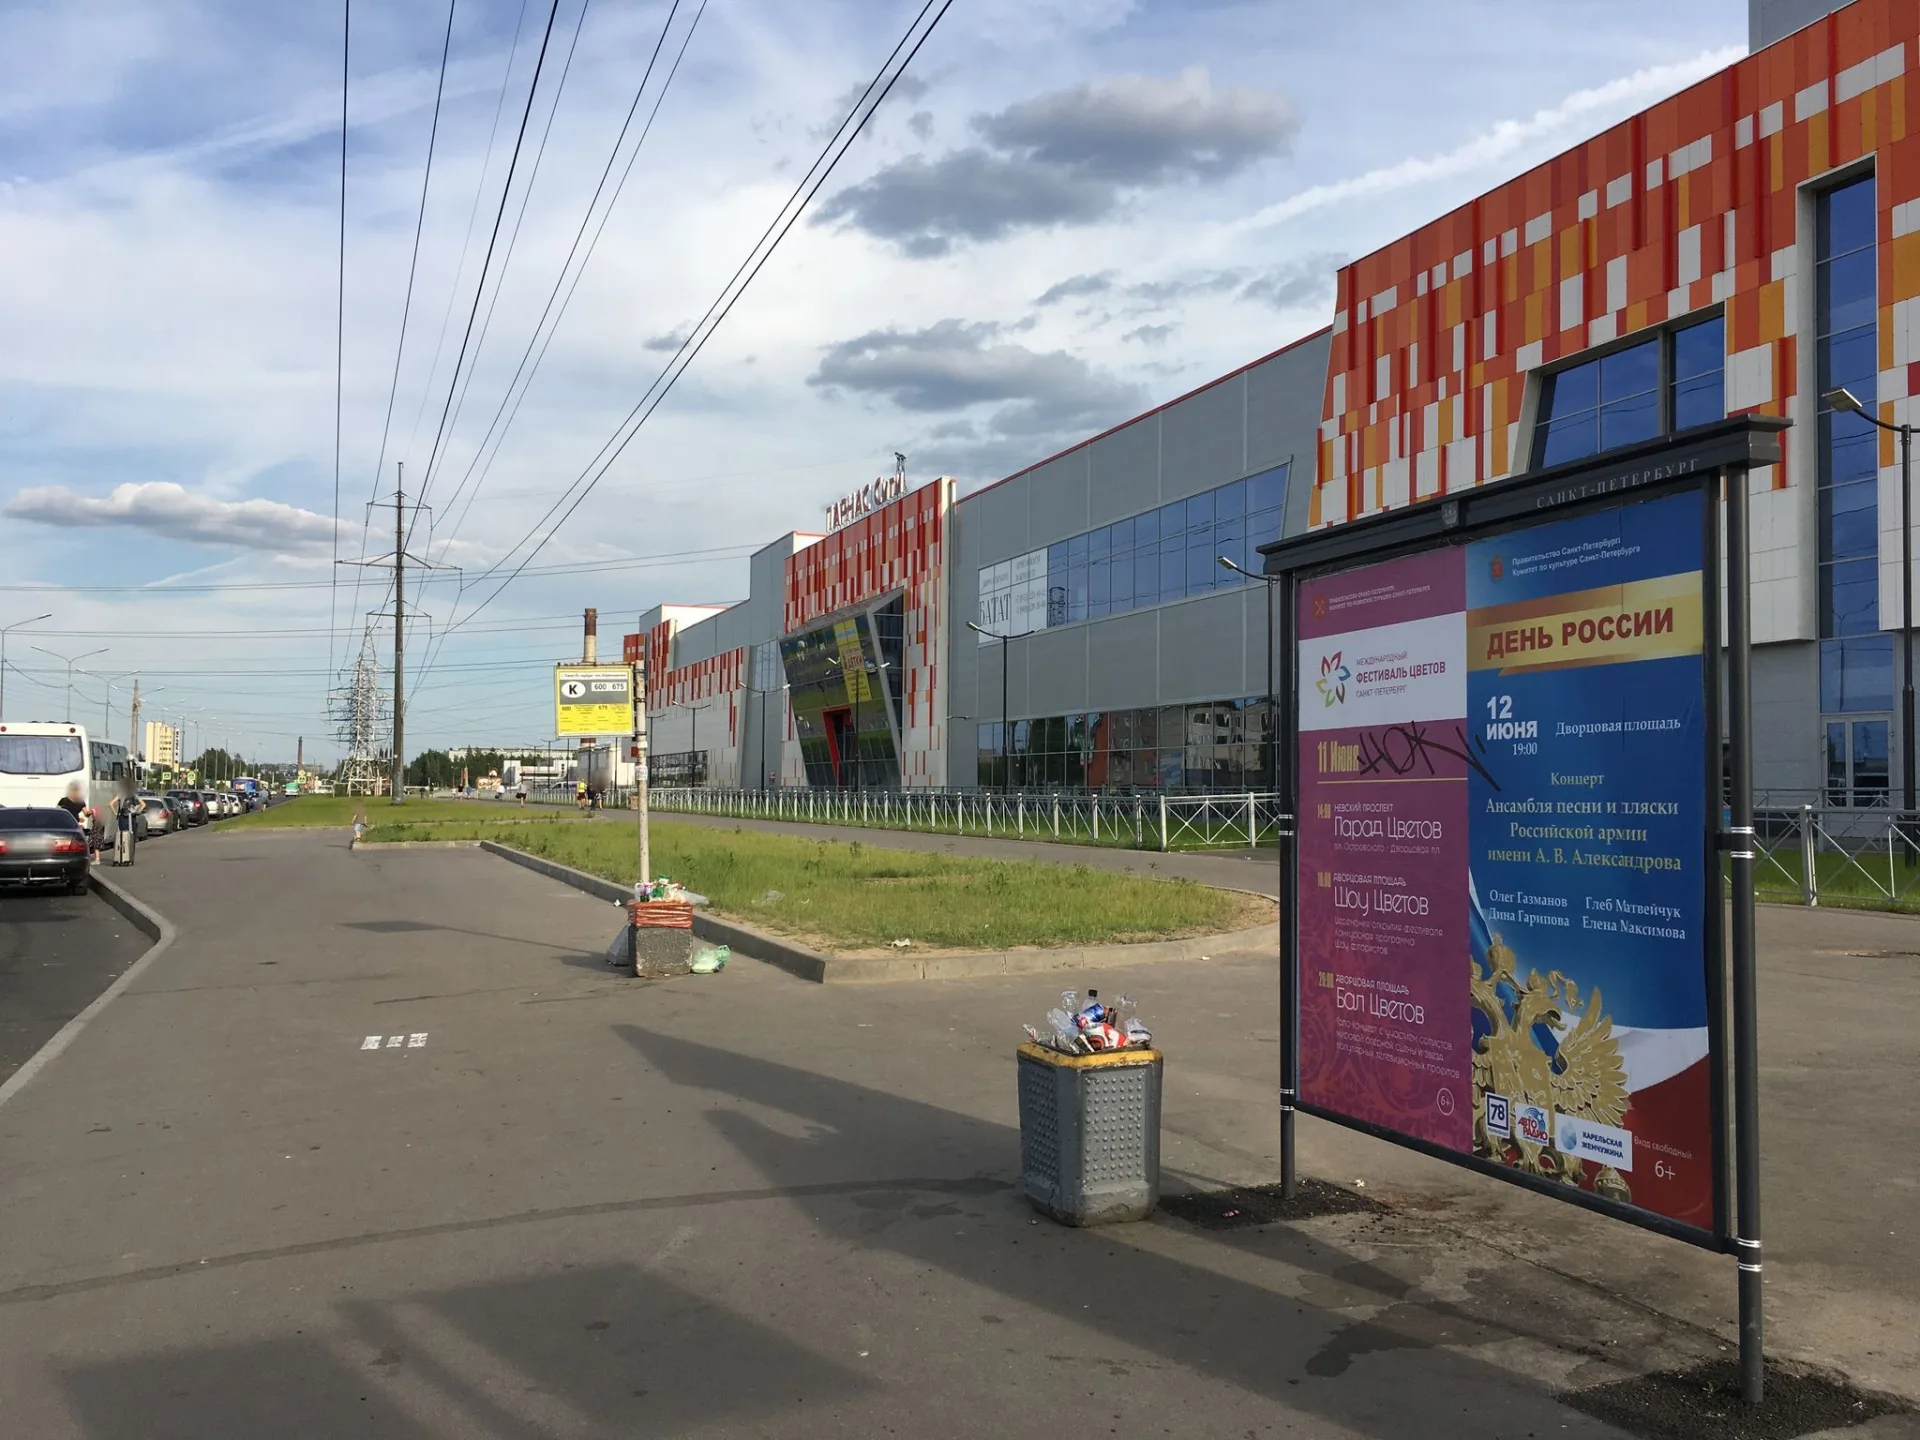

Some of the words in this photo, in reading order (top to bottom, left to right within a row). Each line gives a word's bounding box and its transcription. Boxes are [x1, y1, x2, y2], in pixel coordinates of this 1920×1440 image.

[1536, 458, 1700, 508] САНКТ-ПЕТЕРБУРГ
[826, 484, 872, 532] ПАРНАС
[1512, 549, 1560, 566] Правительство
[1512, 564, 1538, 577] Комитет
[1539, 564, 1548, 572] по
[1548, 558, 1578, 571] культуре
[1579, 544, 1640, 564] Санкт-Петербурга
[980, 594, 1011, 626] БАТАТ
[1487, 626, 1554, 660] ДЕНЬ
[1562, 608, 1674, 646] РОССИИ
[1356, 651, 1408, 667] МЕЖДУНАРОДНЫЙ
[1356, 667, 1408, 684] ФЕСТИВАЛЬ
[1410, 662, 1446, 678] ЦВЕТОВ
[1356, 684, 1408, 698] САНКТ-ПЕТЕРБУРГ
[1486, 695, 1512, 720] 12
[1486, 720, 1538, 740] ИЮНЯ
[1556, 720, 1622, 738] Дворцовая
[1624, 718, 1681, 732] площадь
[1318, 741, 1327, 772] 11
[1330, 741, 1360, 772] Июня
[1512, 742, 1538, 756] 19:00
[1551, 772, 1604, 788] Концерт
[1334, 802, 1362, 812] НЕВСКИЙ
[1362, 802, 1394, 812] ПРОСПЕКТ
[1486, 798, 1552, 814] Ансамбля
[1556, 801, 1601, 814] песни
[1606, 802, 1617, 814] и
[1334, 816, 1384, 840] Парад
[1388, 816, 1442, 840] Цветов
[1510, 822, 1594, 840] Российской
[1598, 827, 1648, 845] армии
[1488, 850, 1530, 863] имени
[1535, 850, 1550, 864] А.
[1554, 848, 1568, 864] В.
[1572, 850, 1682, 874] Александрова
[1334, 873, 1372, 884] ДВОРЦОВАЯ
[1374, 875, 1407, 887] ПЛОЩАДЬ
[1334, 886, 1368, 916] Шоу
[1374, 889, 1428, 916] Цветов
[1489, 889, 1514, 904] Олег
[1517, 892, 1568, 908] Газманов
[1586, 896, 1612, 911] Глеб
[1616, 898, 1681, 921] Матвейчук
[1488, 907, 1516, 922] Дина
[1518, 910, 1570, 928] Гарипова
[1582, 916, 1617, 932] Елена
[1404, 925, 1442, 936] фестиваля
[1336, 974, 1374, 989] ДВОРЦОВАЯ
[1376, 981, 1410, 995] ПЛОЩАДЬ
[1336, 987, 1364, 1014] Бал
[1370, 993, 1424, 1024] Цветов
[1440, 1096, 1450, 1106] 6+
[1490, 1103, 1506, 1121] 78
[1518, 1117, 1538, 1135] АВТО
[1523, 1126, 1548, 1141] РАДИО
[1582, 1131, 1622, 1148] КАРЕЛЬСКАЯ
[1634, 1136, 1651, 1149] Вход
[1652, 1142, 1693, 1160] свободный
[1654, 1160, 1676, 1180] 6+
